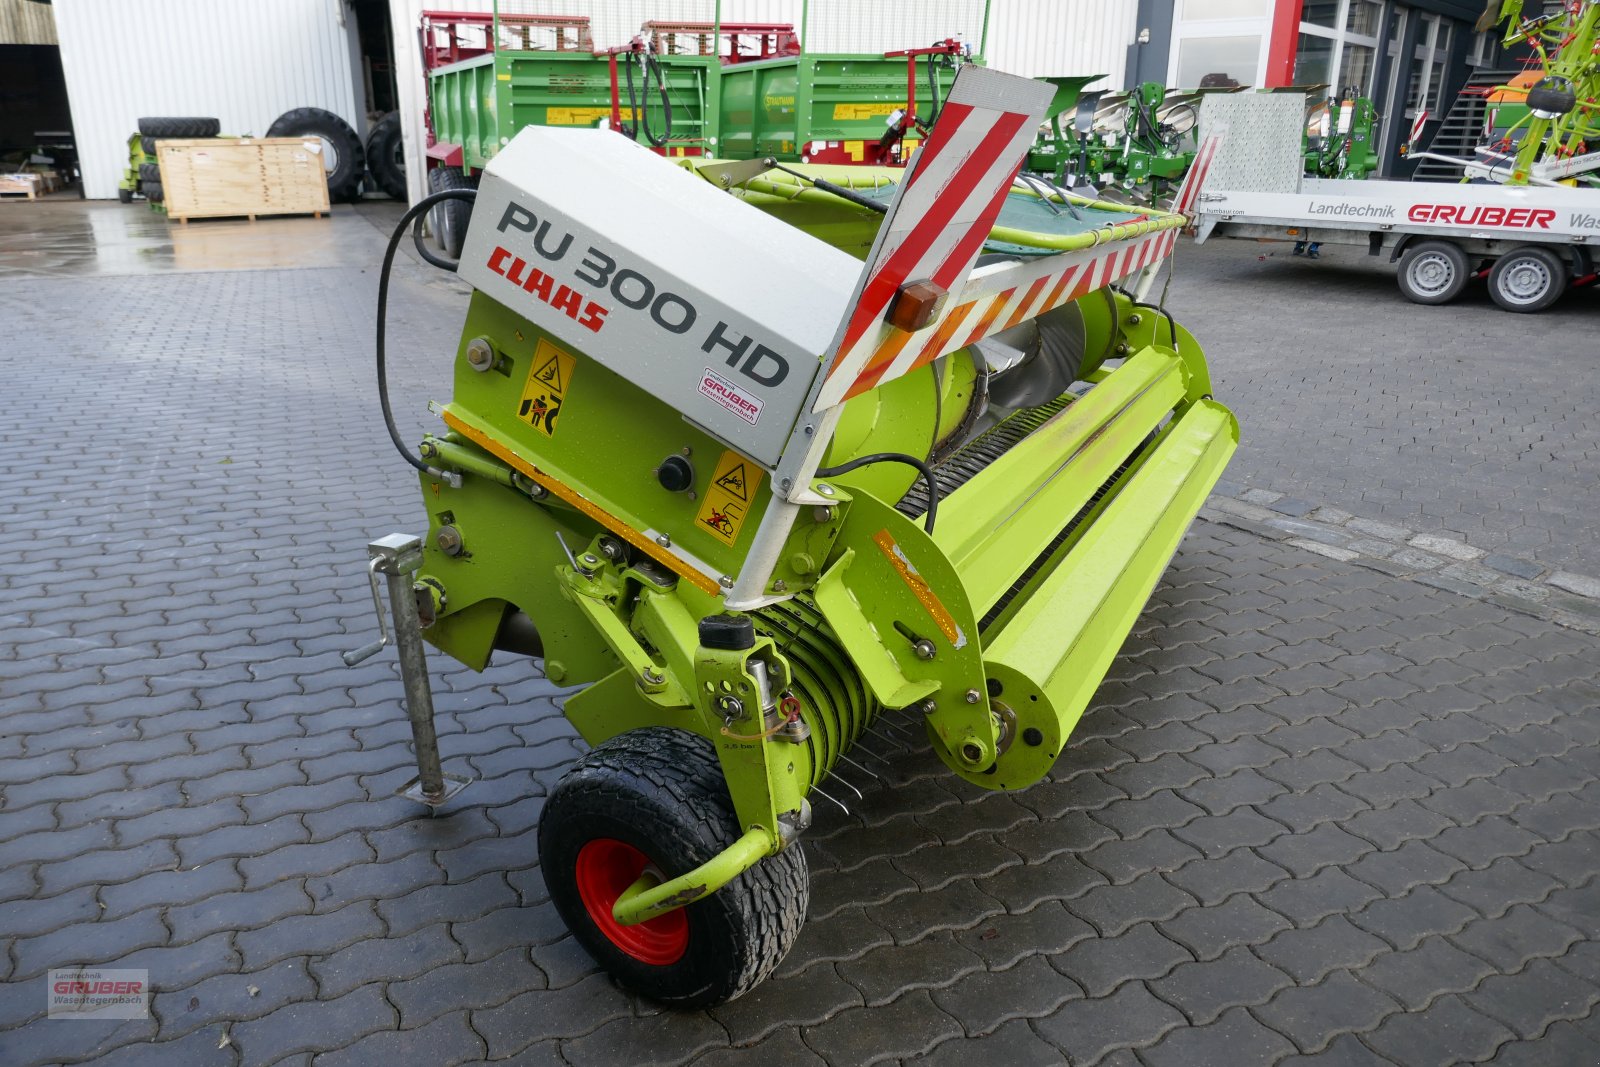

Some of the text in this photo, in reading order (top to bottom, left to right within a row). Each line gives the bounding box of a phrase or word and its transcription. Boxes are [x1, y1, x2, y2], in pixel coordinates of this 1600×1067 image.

[1308, 201, 1396, 218] Landtechnik
[1408, 204, 1556, 229] GRUBER
[486, 246, 609, 333] CLAAS
[496, 201, 575, 262] PU
[574, 246, 697, 334] 300
[700, 320, 790, 388] HD
[701, 385, 754, 421] Wasentegernbach
[704, 377, 758, 415] GRUBER
